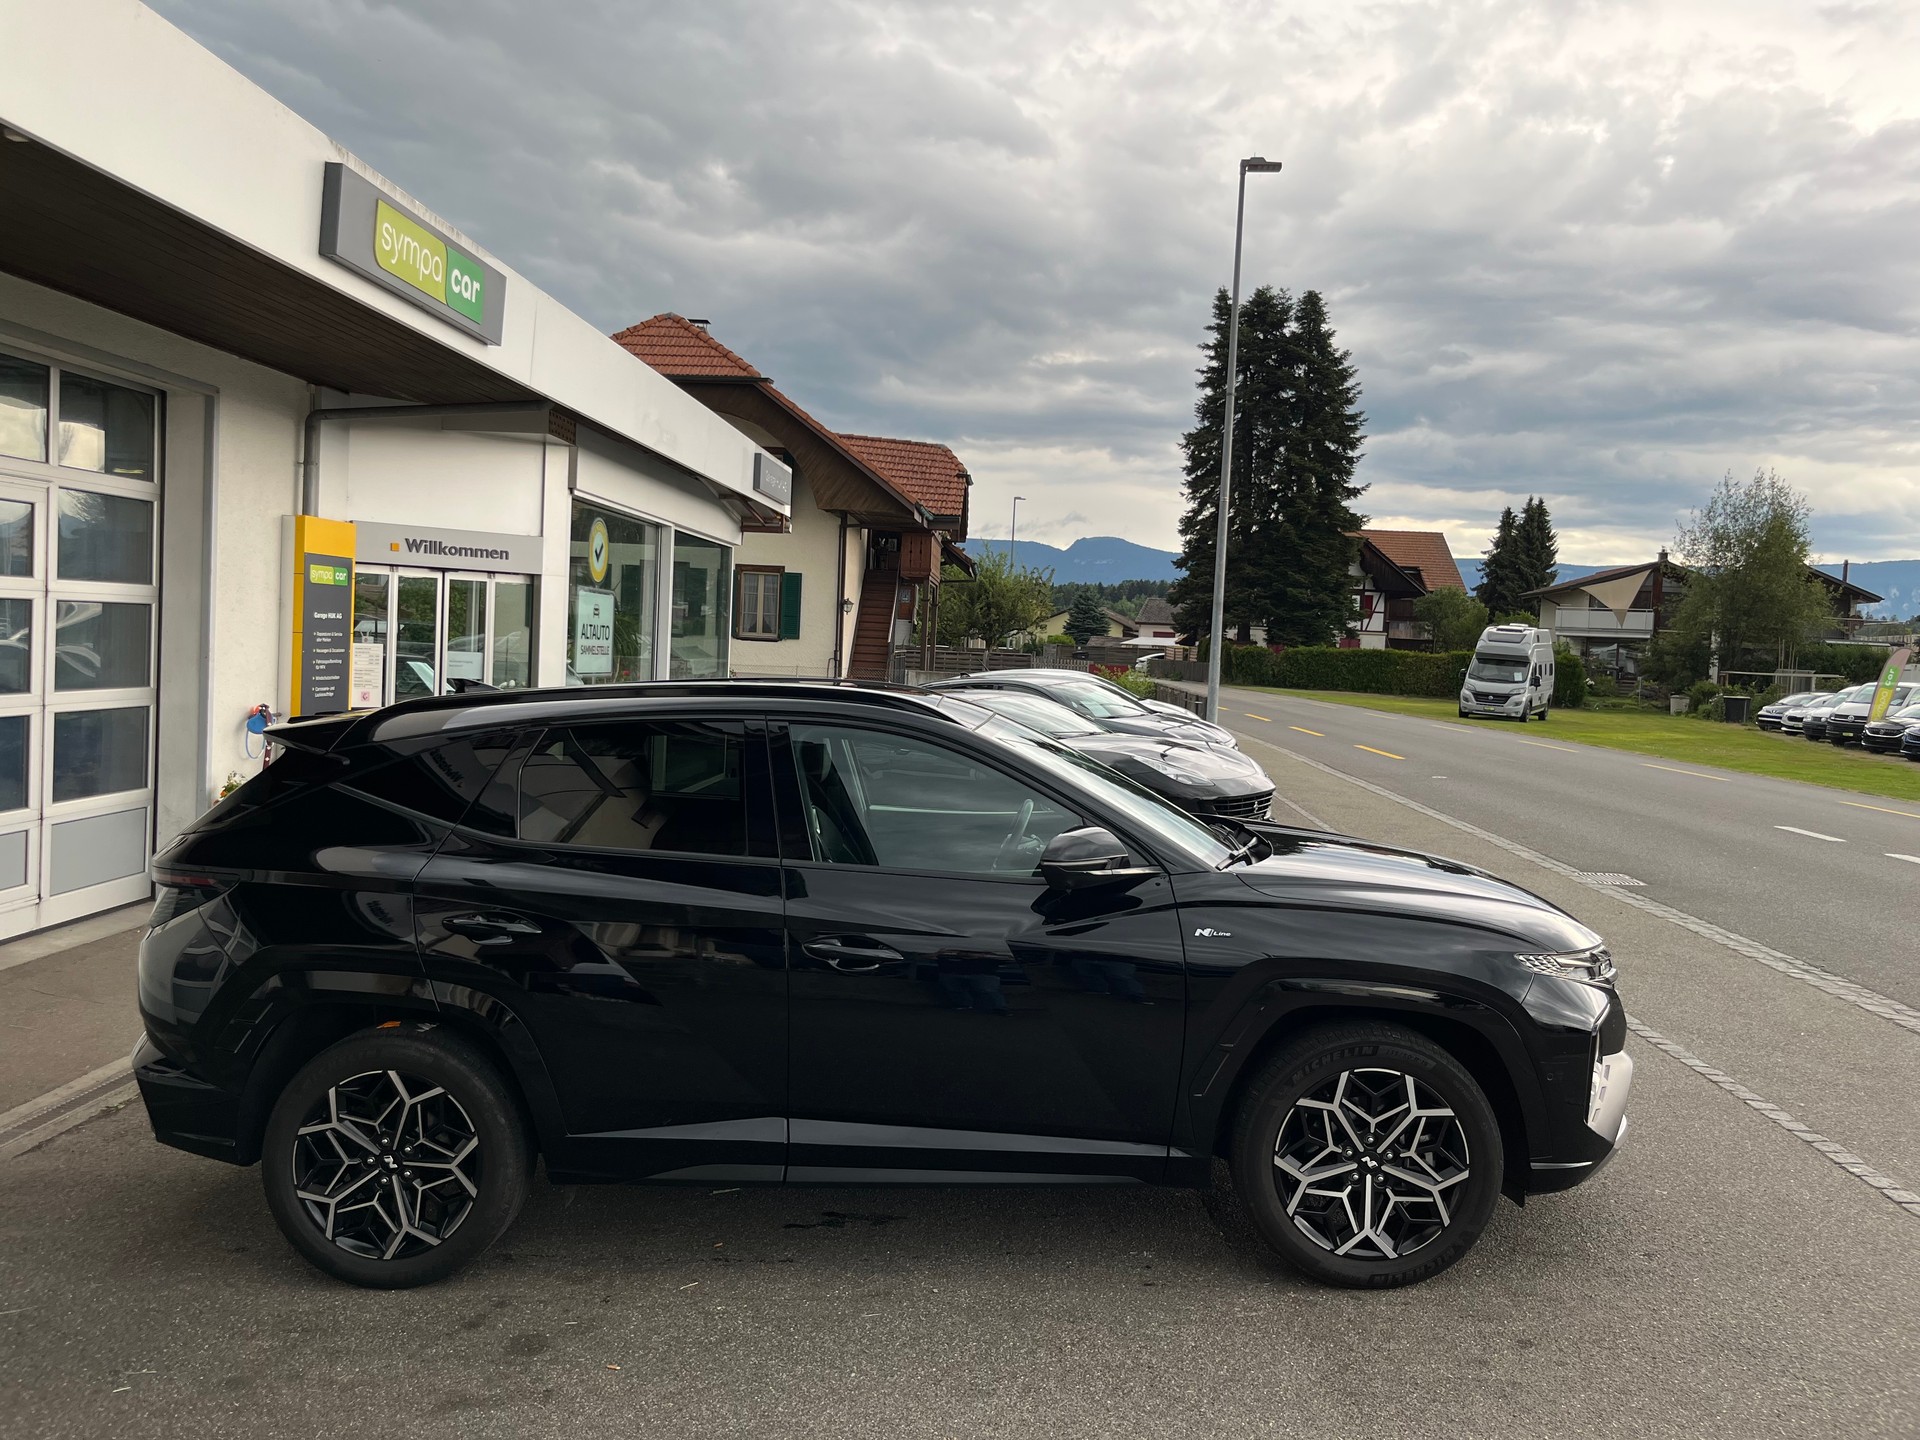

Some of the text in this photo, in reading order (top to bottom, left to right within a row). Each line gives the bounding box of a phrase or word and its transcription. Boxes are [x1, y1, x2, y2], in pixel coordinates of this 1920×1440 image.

[381, 222, 480, 303] sympa car
[404, 537, 510, 561] Willkommen
[312, 569, 347, 582] sympa car
[581, 623, 610, 641] ALTAUTO
[580, 644, 610, 656] SAMMELSTELLE
[1885, 668, 1895, 687] car
[1292, 1045, 1374, 1084] MICHELIN
